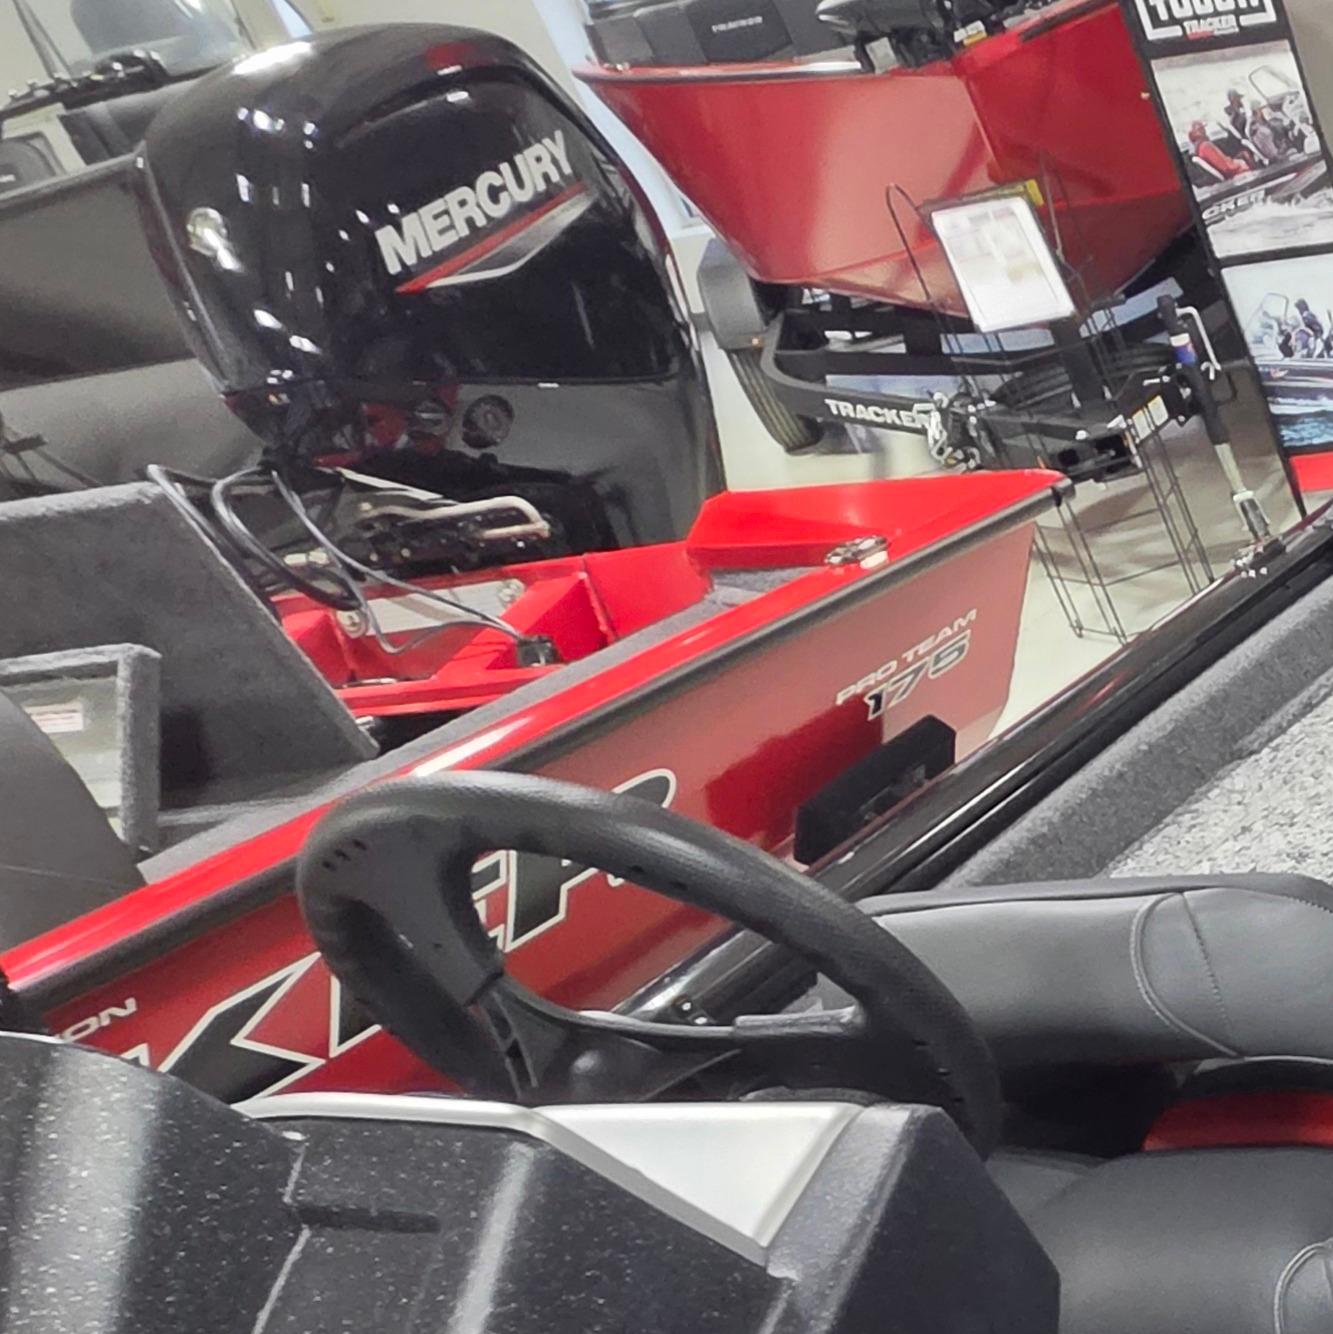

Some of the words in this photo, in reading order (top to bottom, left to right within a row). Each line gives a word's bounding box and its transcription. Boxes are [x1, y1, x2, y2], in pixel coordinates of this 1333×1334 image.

[374, 129, 573, 276] MERCURY
[835, 659, 898, 706] PRO
[901, 608, 977, 663] TEAM
[864, 629, 972, 721] 175
